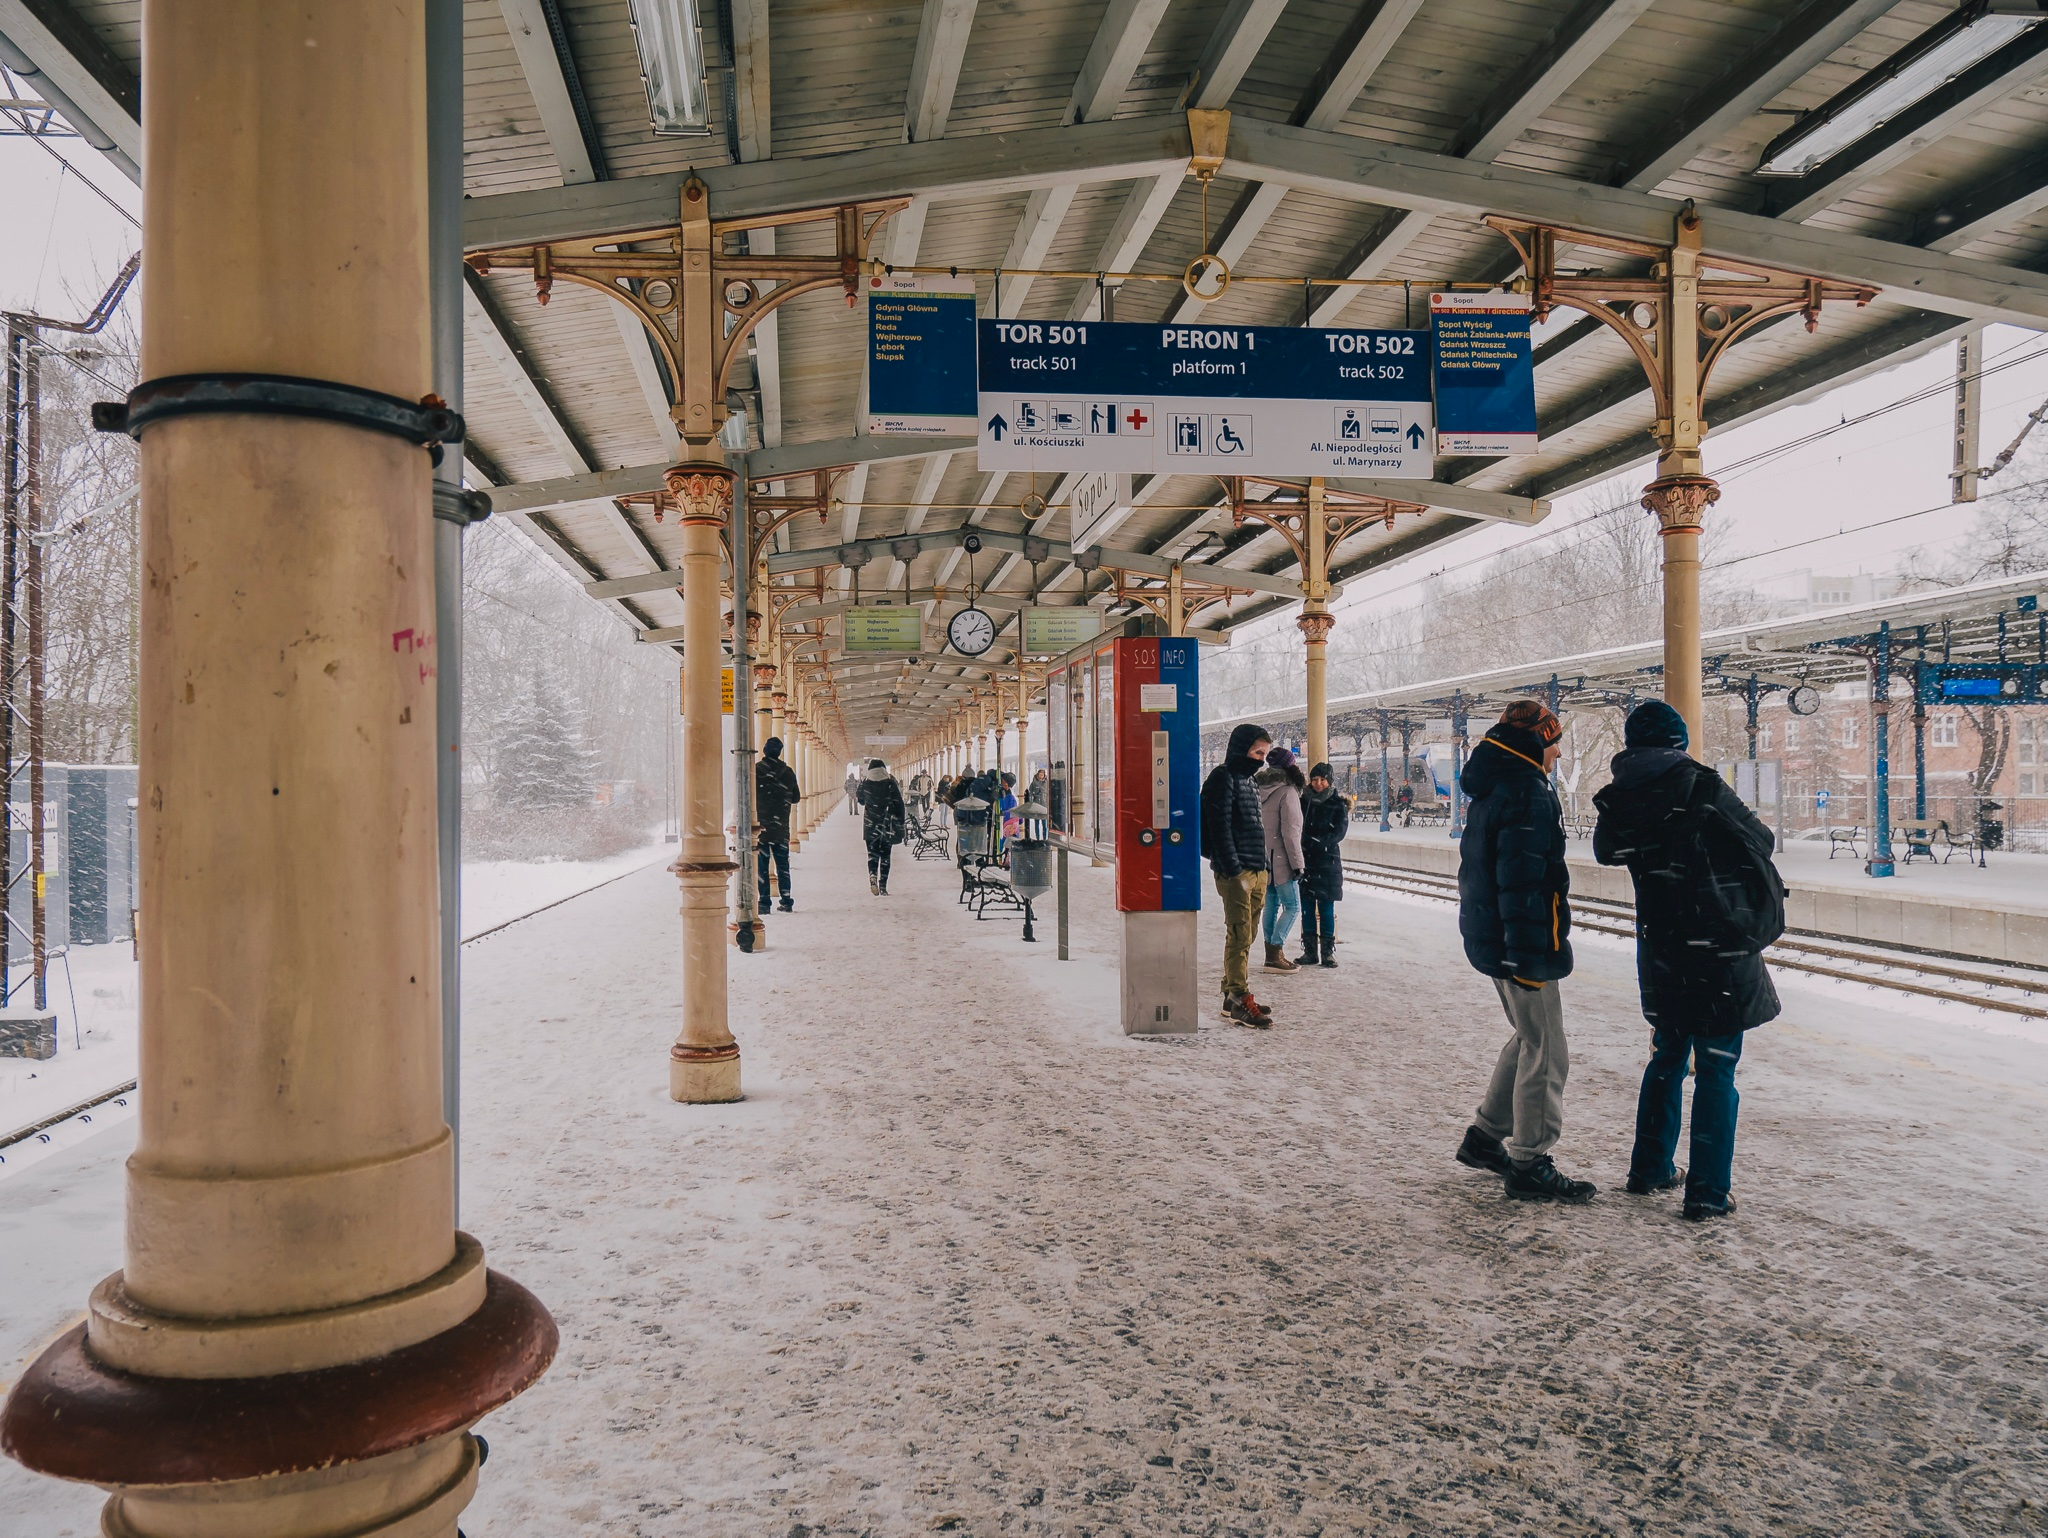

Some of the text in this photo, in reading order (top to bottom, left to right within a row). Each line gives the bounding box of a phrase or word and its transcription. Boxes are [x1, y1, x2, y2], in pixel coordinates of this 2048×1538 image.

[893, 281, 916, 289] Sopot
[1453, 297, 1474, 305] Sopot
[875, 304, 938, 313] Gdynia Główna
[875, 323, 897, 331] Reda
[1438, 321, 1493, 329] Sopot Wyścigi
[875, 333, 922, 342] Wejherowo
[996, 324, 1087, 345] TOR 501
[1162, 329, 1255, 350] PERON 1
[1439, 331, 1468, 339] Gdańsk
[876, 343, 905, 352] Lębork
[1325, 334, 1415, 355] TOR 502
[1470, 341, 1507, 349] Wrzeszcz
[875, 353, 905, 362] Słupsk
[1440, 350, 1518, 359] Gdańsk Politechnika
[1010, 355, 1077, 371] track 501
[1172, 359, 1246, 376] platform 1
[1472, 360, 1501, 370] Główny
[1339, 364, 1404, 380] track 502
[1013, 436, 1085, 447] ul. Kościuszki
[1310, 442, 1402, 455] Al. Niepodległości
[1333, 456, 1402, 469] ul. Marynarzy
[1134, 649, 1156, 665] SOS
[1163, 649, 1186, 665] INFO
